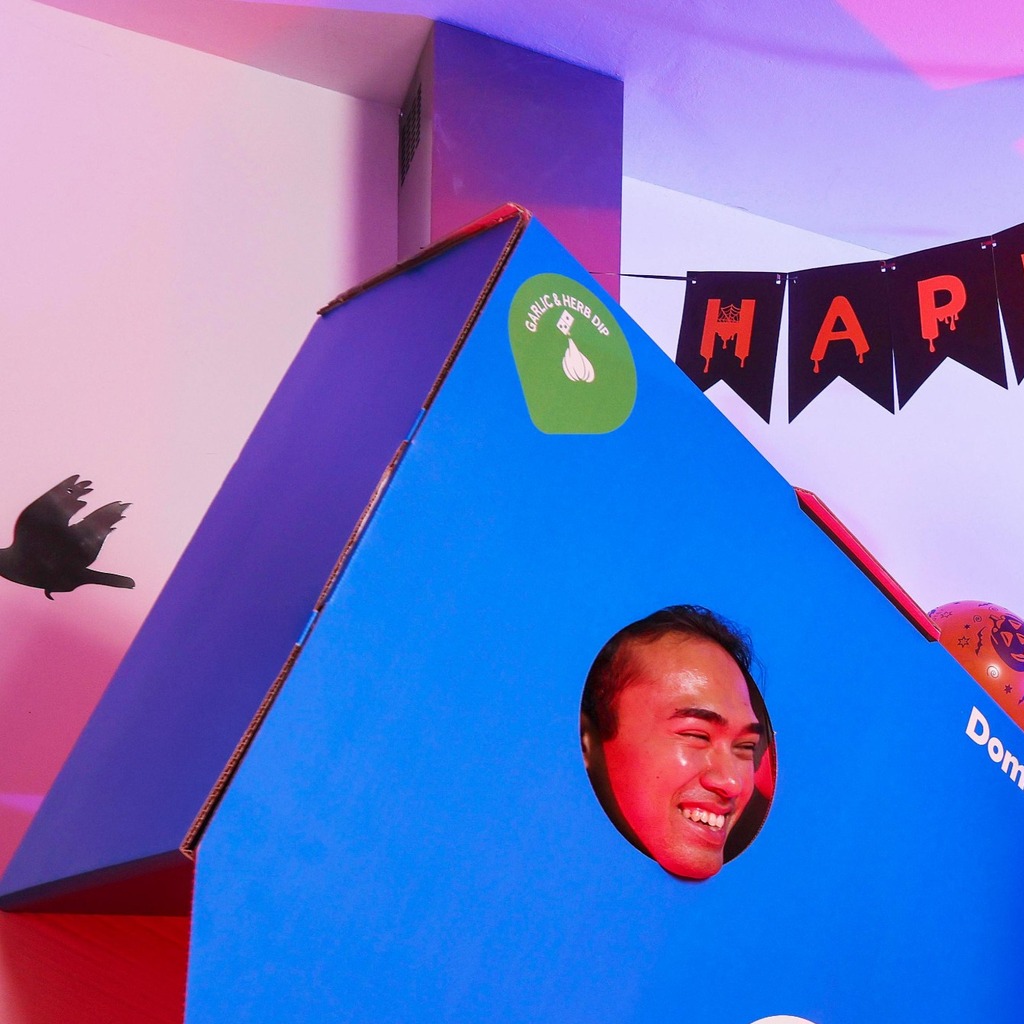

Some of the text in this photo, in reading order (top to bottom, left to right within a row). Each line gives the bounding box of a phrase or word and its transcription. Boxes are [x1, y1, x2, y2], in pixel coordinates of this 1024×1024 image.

[525, 292, 610, 336] GARLIC & HERB DIP
